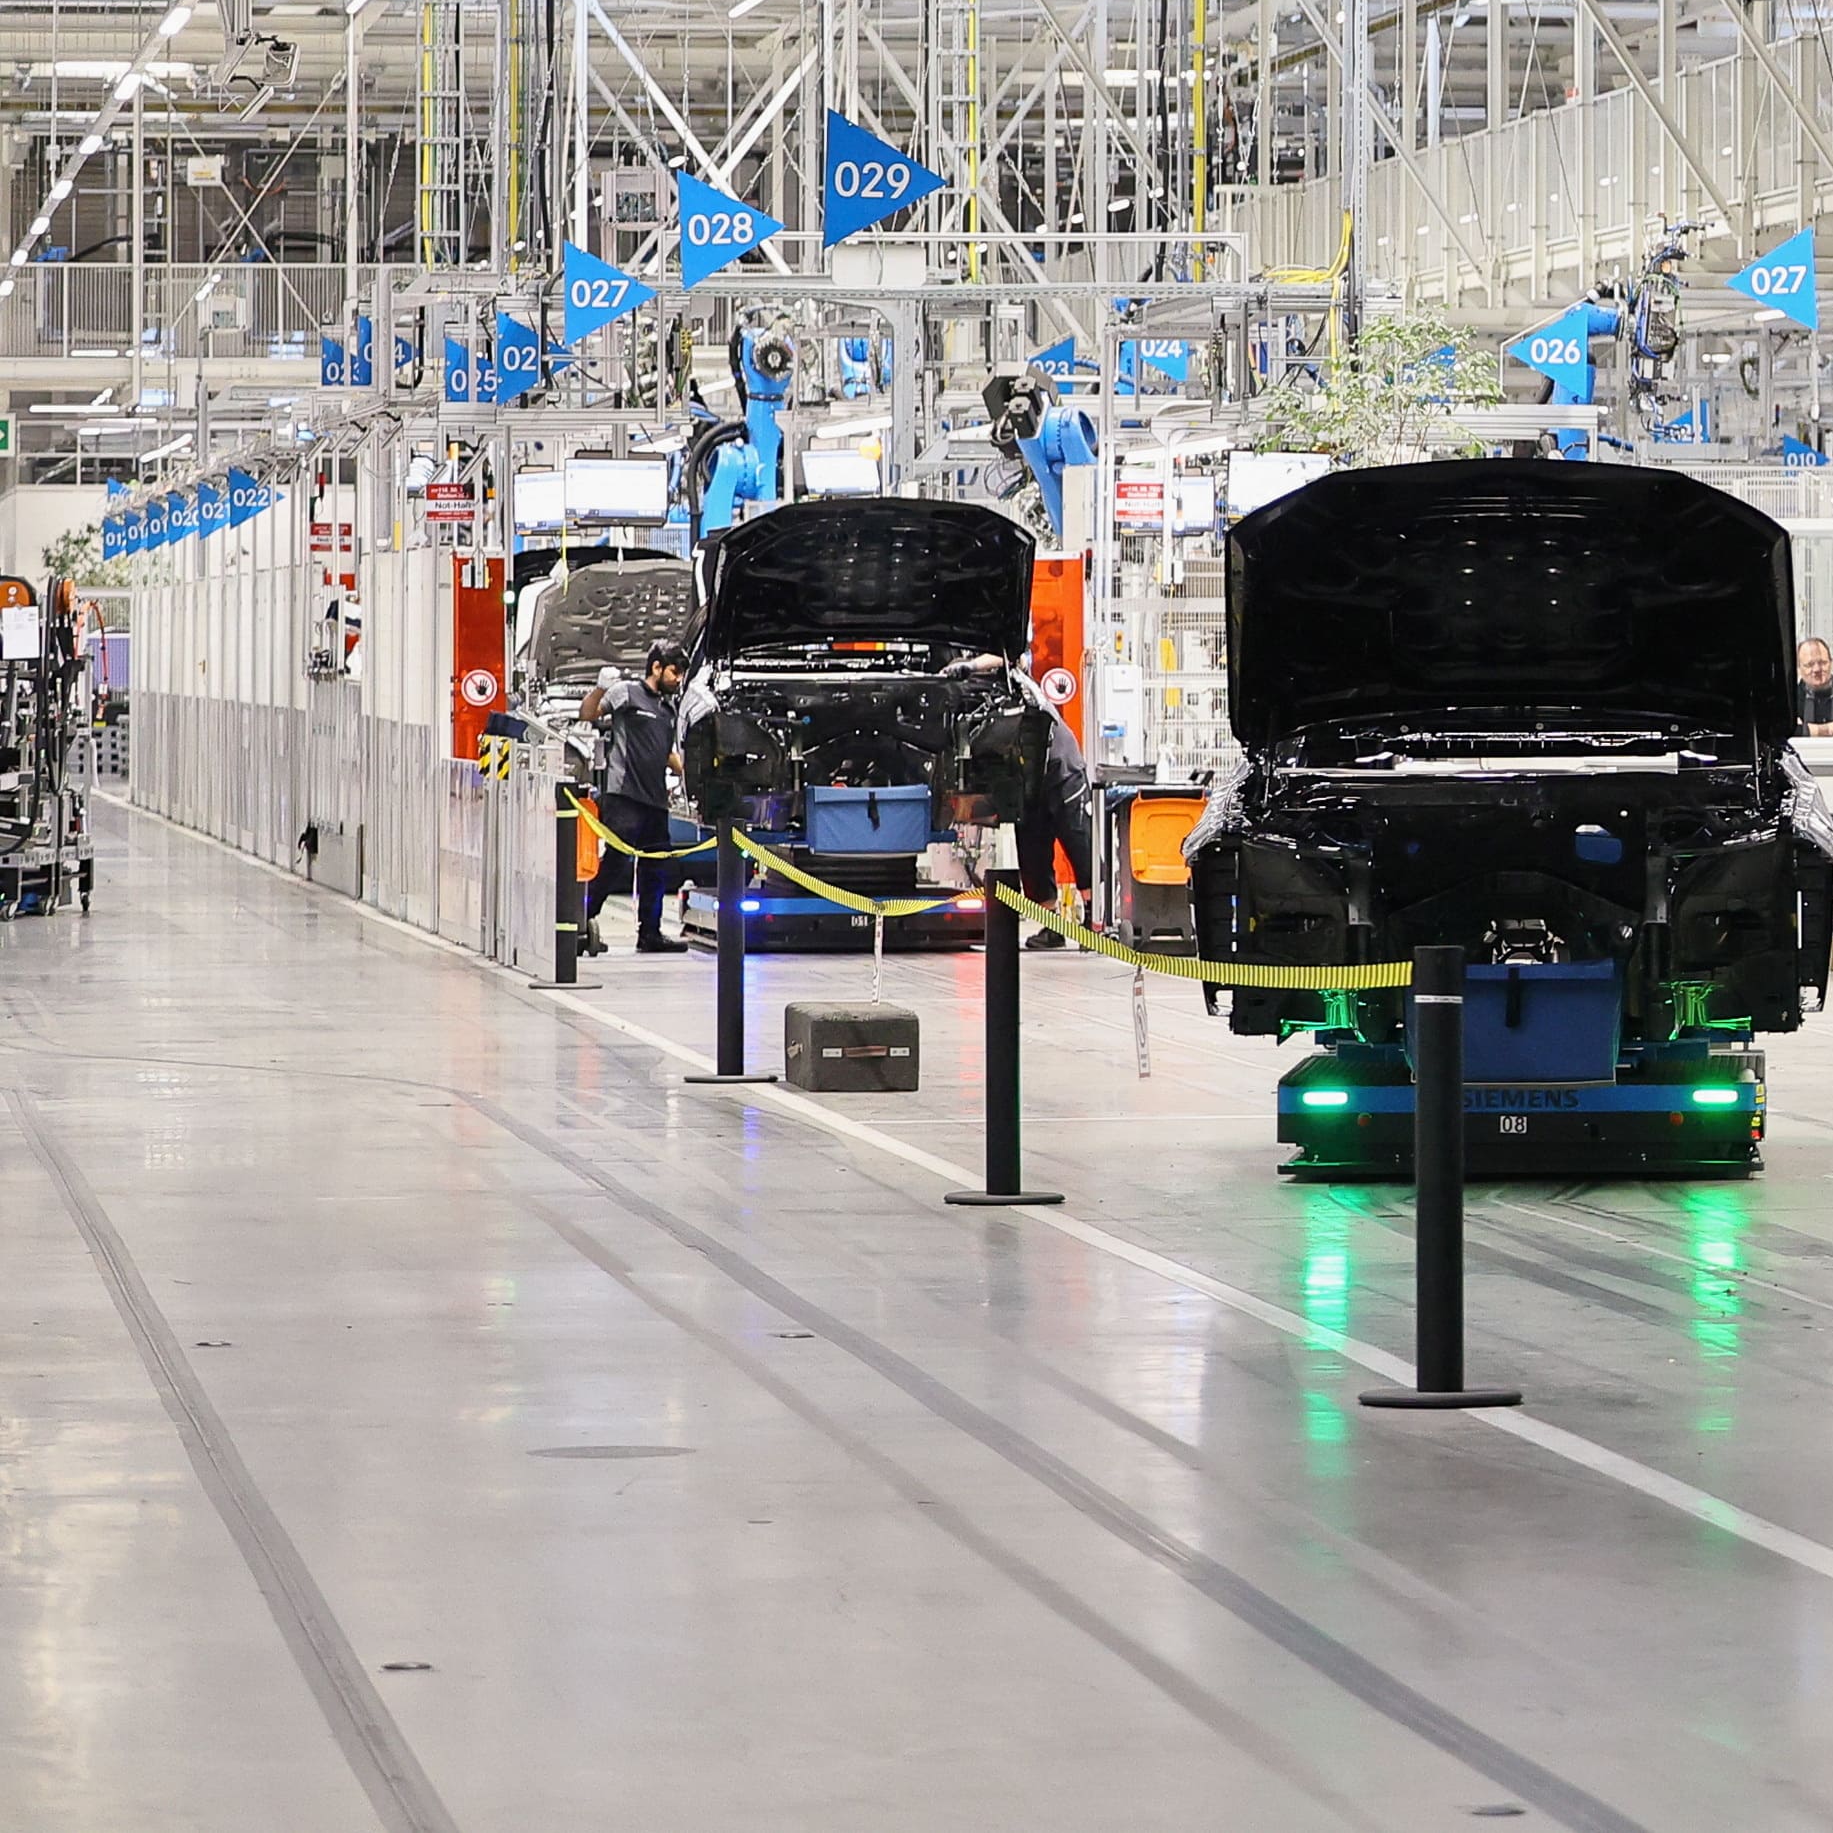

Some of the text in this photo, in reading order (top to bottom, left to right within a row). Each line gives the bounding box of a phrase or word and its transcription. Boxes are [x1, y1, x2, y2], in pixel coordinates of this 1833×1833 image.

[834, 160, 912, 200] 029
[688, 212, 755, 246] 028
[1751, 265, 1807, 295] 027
[570, 279, 630, 308] 027
[503, 345, 537, 371] 02
[1140, 339, 1183, 358] 024
[1530, 338, 1581, 364] 026
[1786, 452, 1817, 466] 010
[233, 488, 269, 508] 022
[202, 502, 231, 520] 021
[128, 525, 148, 542] 01
[1462, 1088, 1580, 1109] SIEMENS
[1501, 1116, 1526, 1133] 08
